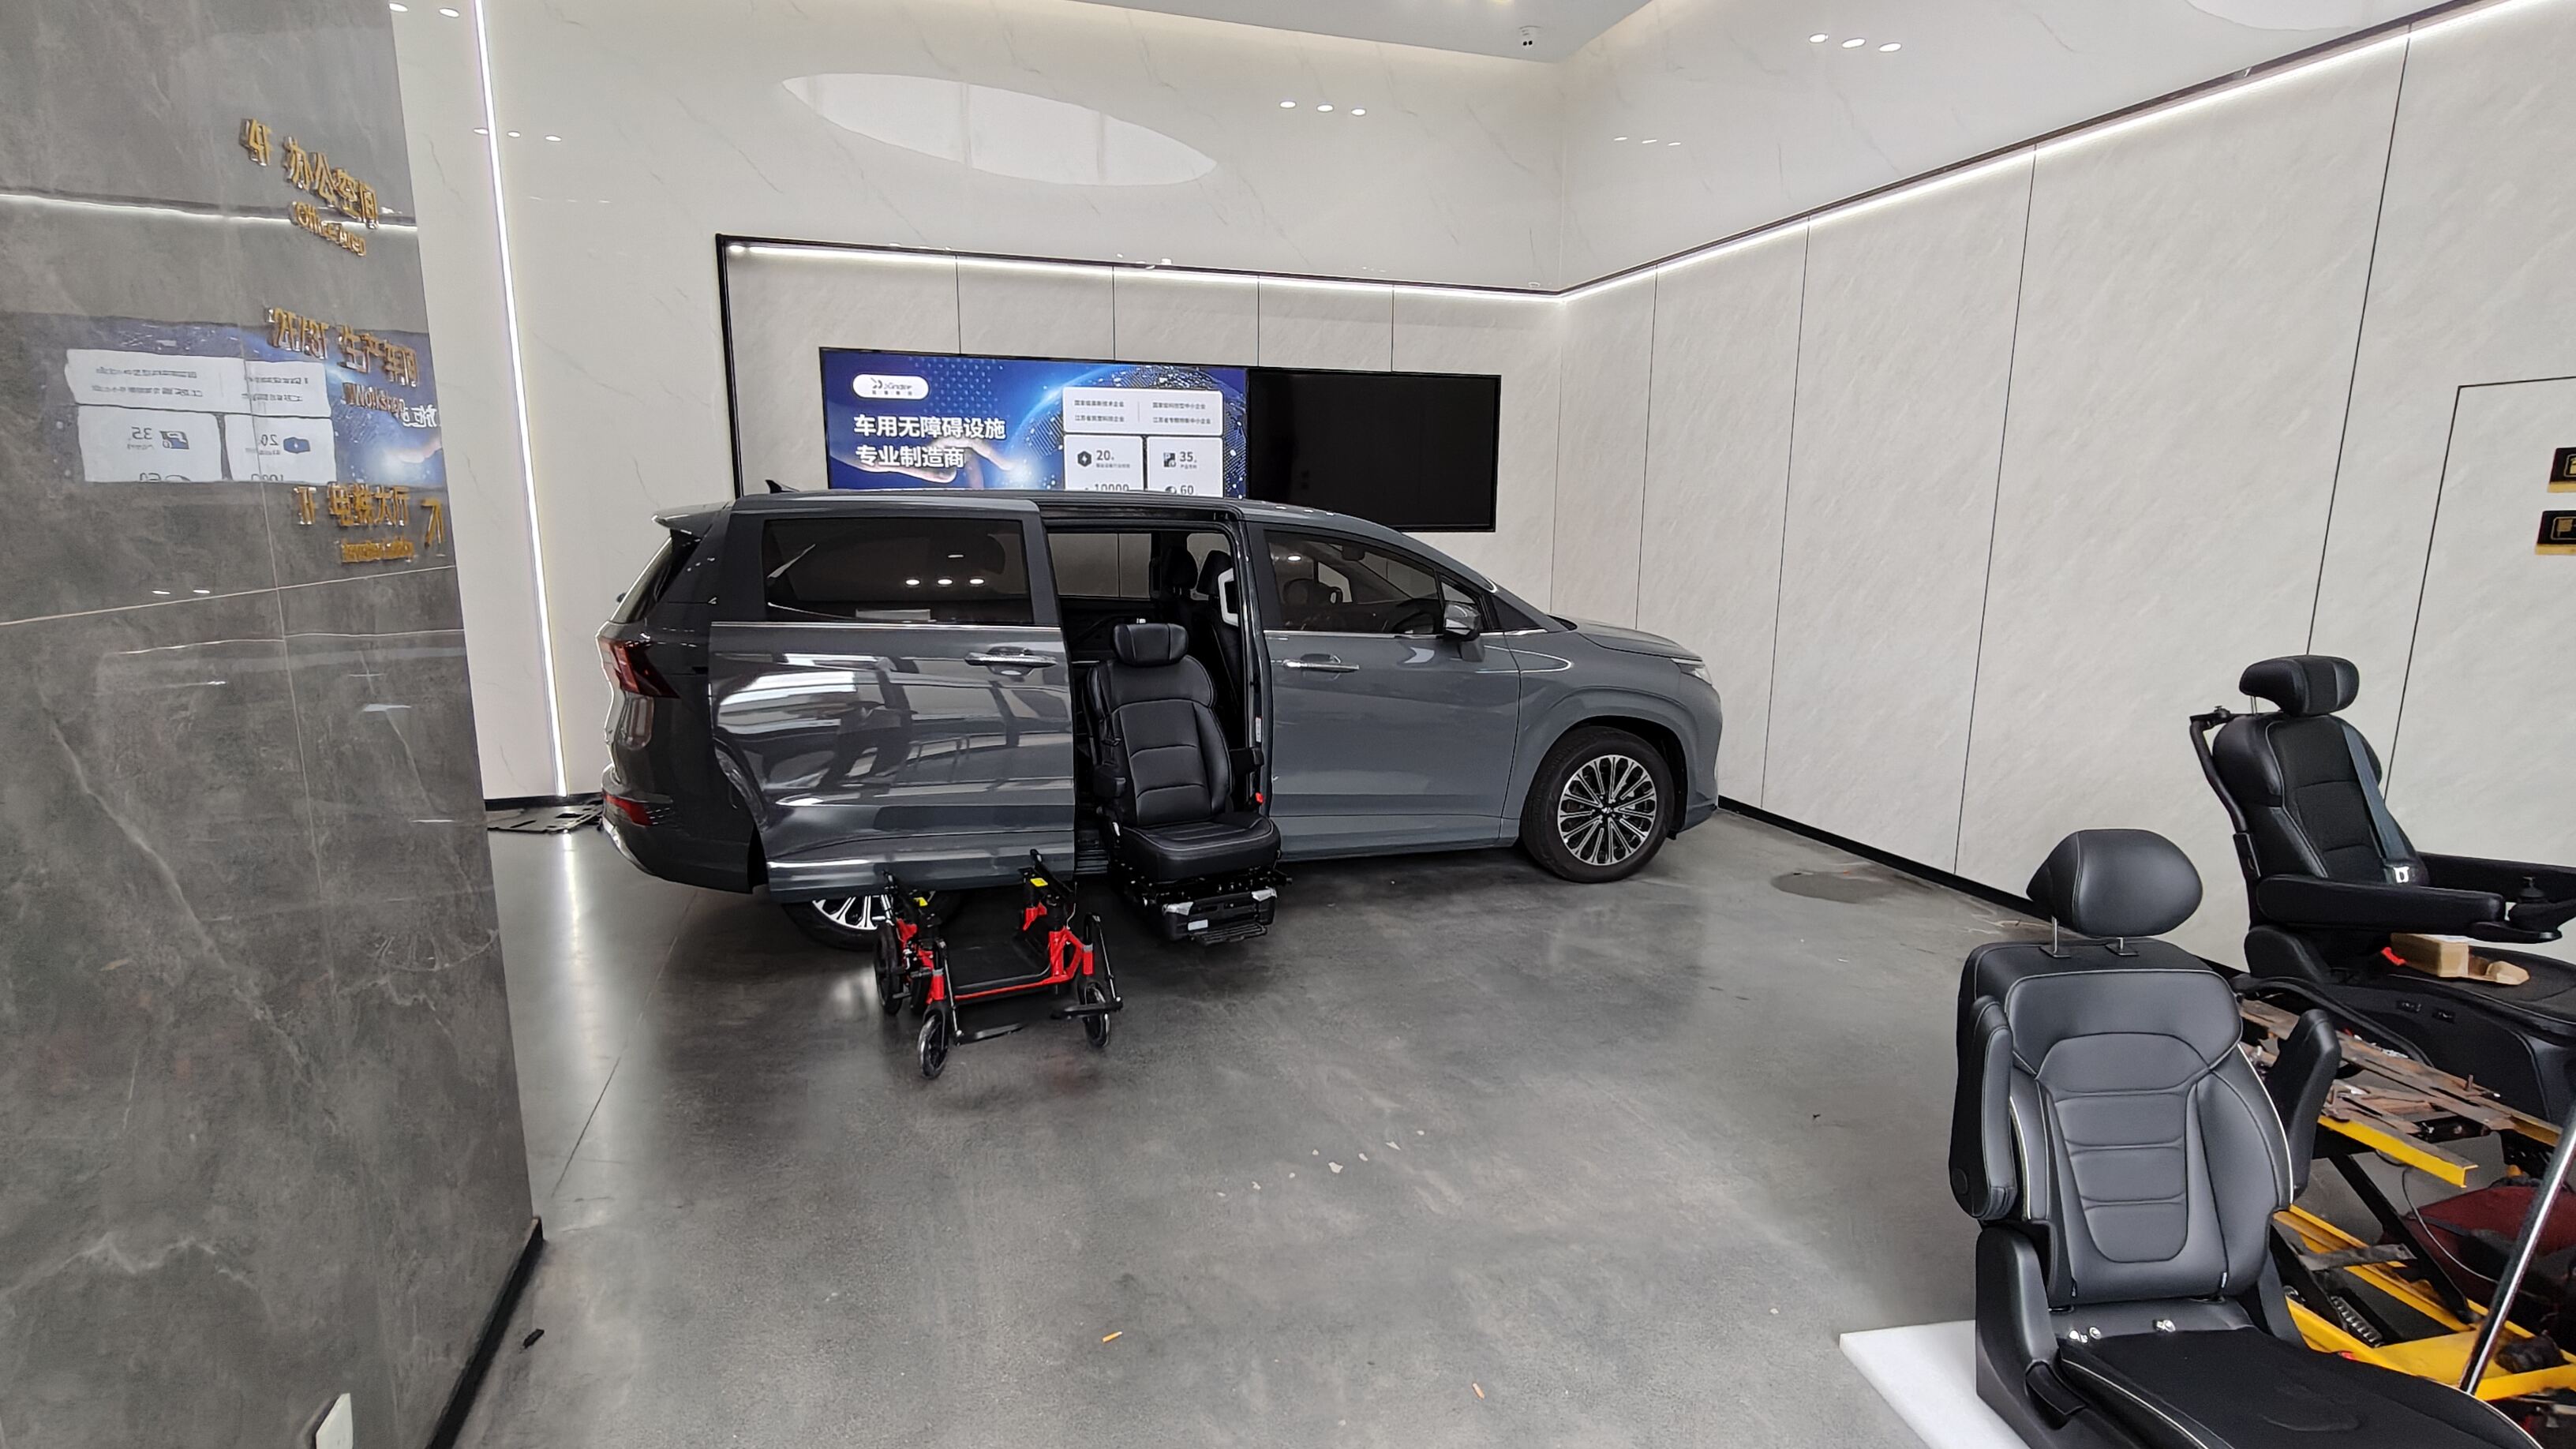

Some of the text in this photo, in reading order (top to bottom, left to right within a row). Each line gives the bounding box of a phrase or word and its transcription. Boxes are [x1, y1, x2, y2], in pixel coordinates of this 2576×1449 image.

[337, 324, 418, 388] 生产车间
[854, 414, 1006, 440] 车用无障碍设施
[856, 444, 965, 469] 专业制造商
